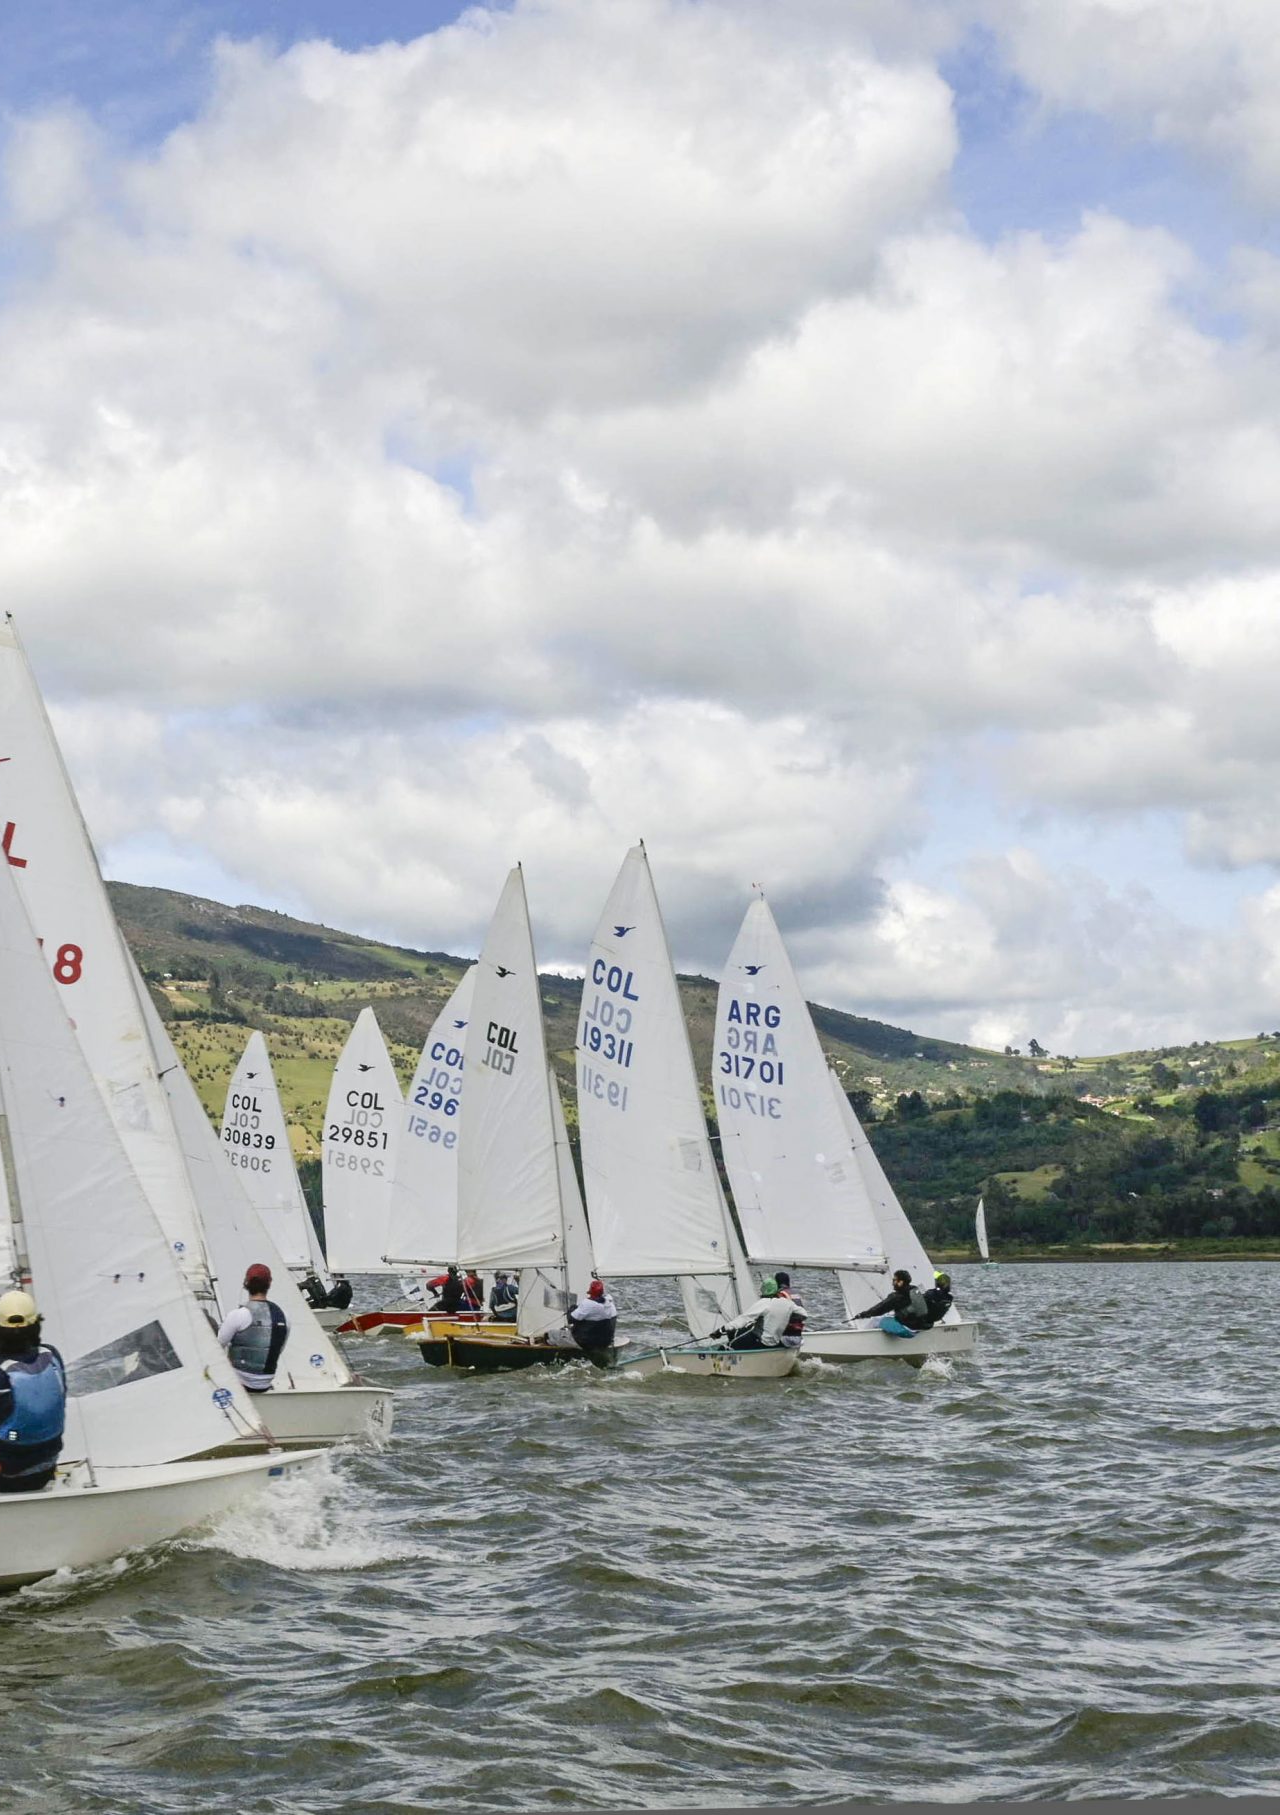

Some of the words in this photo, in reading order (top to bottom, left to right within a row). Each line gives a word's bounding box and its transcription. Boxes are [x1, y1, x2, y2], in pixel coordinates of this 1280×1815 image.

[592, 958, 639, 1002] COL
[727, 999, 781, 1028] ARG
[486, 1021, 518, 1054] COL
[583, 1021, 633, 1068] 19311
[720, 1052, 784, 1086] 31701
[232, 1094, 262, 1113] COL
[346, 1090, 384, 1111] COL
[224, 1127, 275, 1150] 30839
[328, 1124, 388, 1150] 29851
